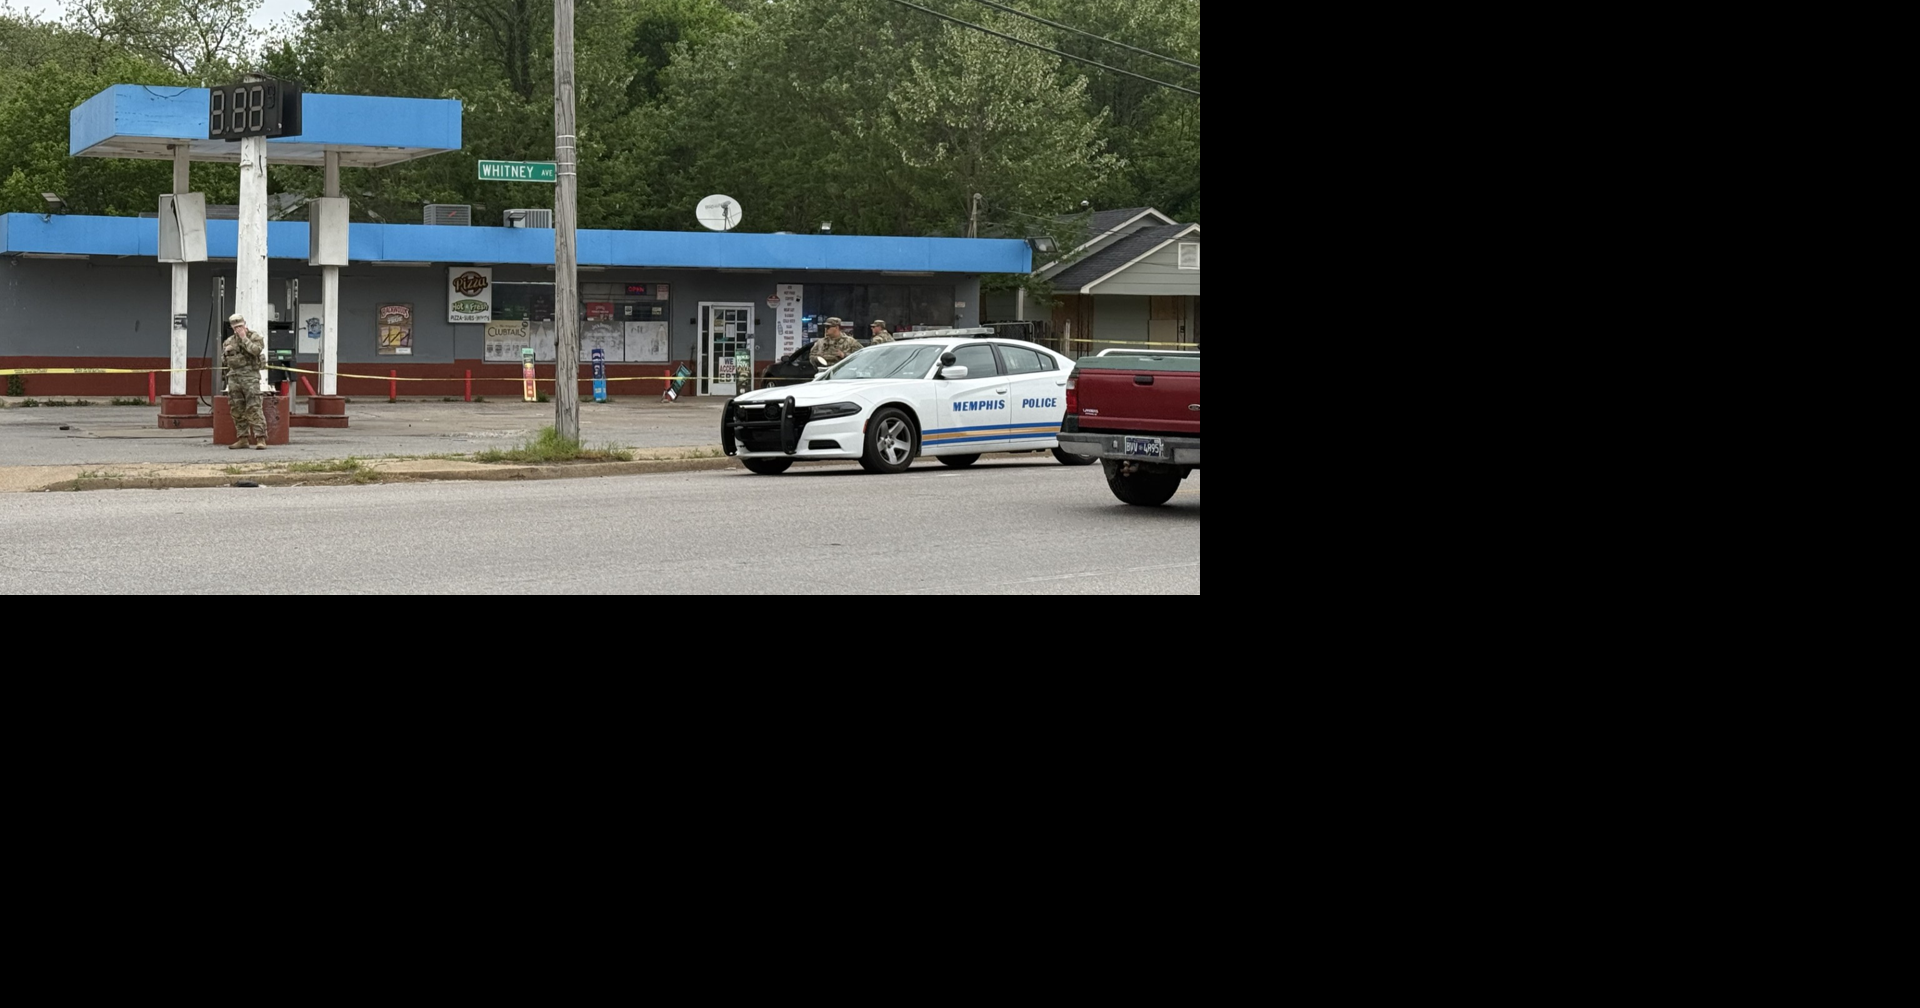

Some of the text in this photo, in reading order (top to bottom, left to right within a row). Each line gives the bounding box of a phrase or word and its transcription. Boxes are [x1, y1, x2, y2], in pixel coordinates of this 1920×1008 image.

[482, 164, 553, 178] WHITNEY AVE
[453, 275, 488, 293] Pizza
[452, 302, 464, 311] Hot
[470, 302, 489, 311] Fresh
[488, 327, 526, 337] CLUBTAILS
[720, 365, 736, 373] ACCEP
[720, 373, 736, 382] EBT
[953, 398, 1057, 411] MEMPHIS POLICE
